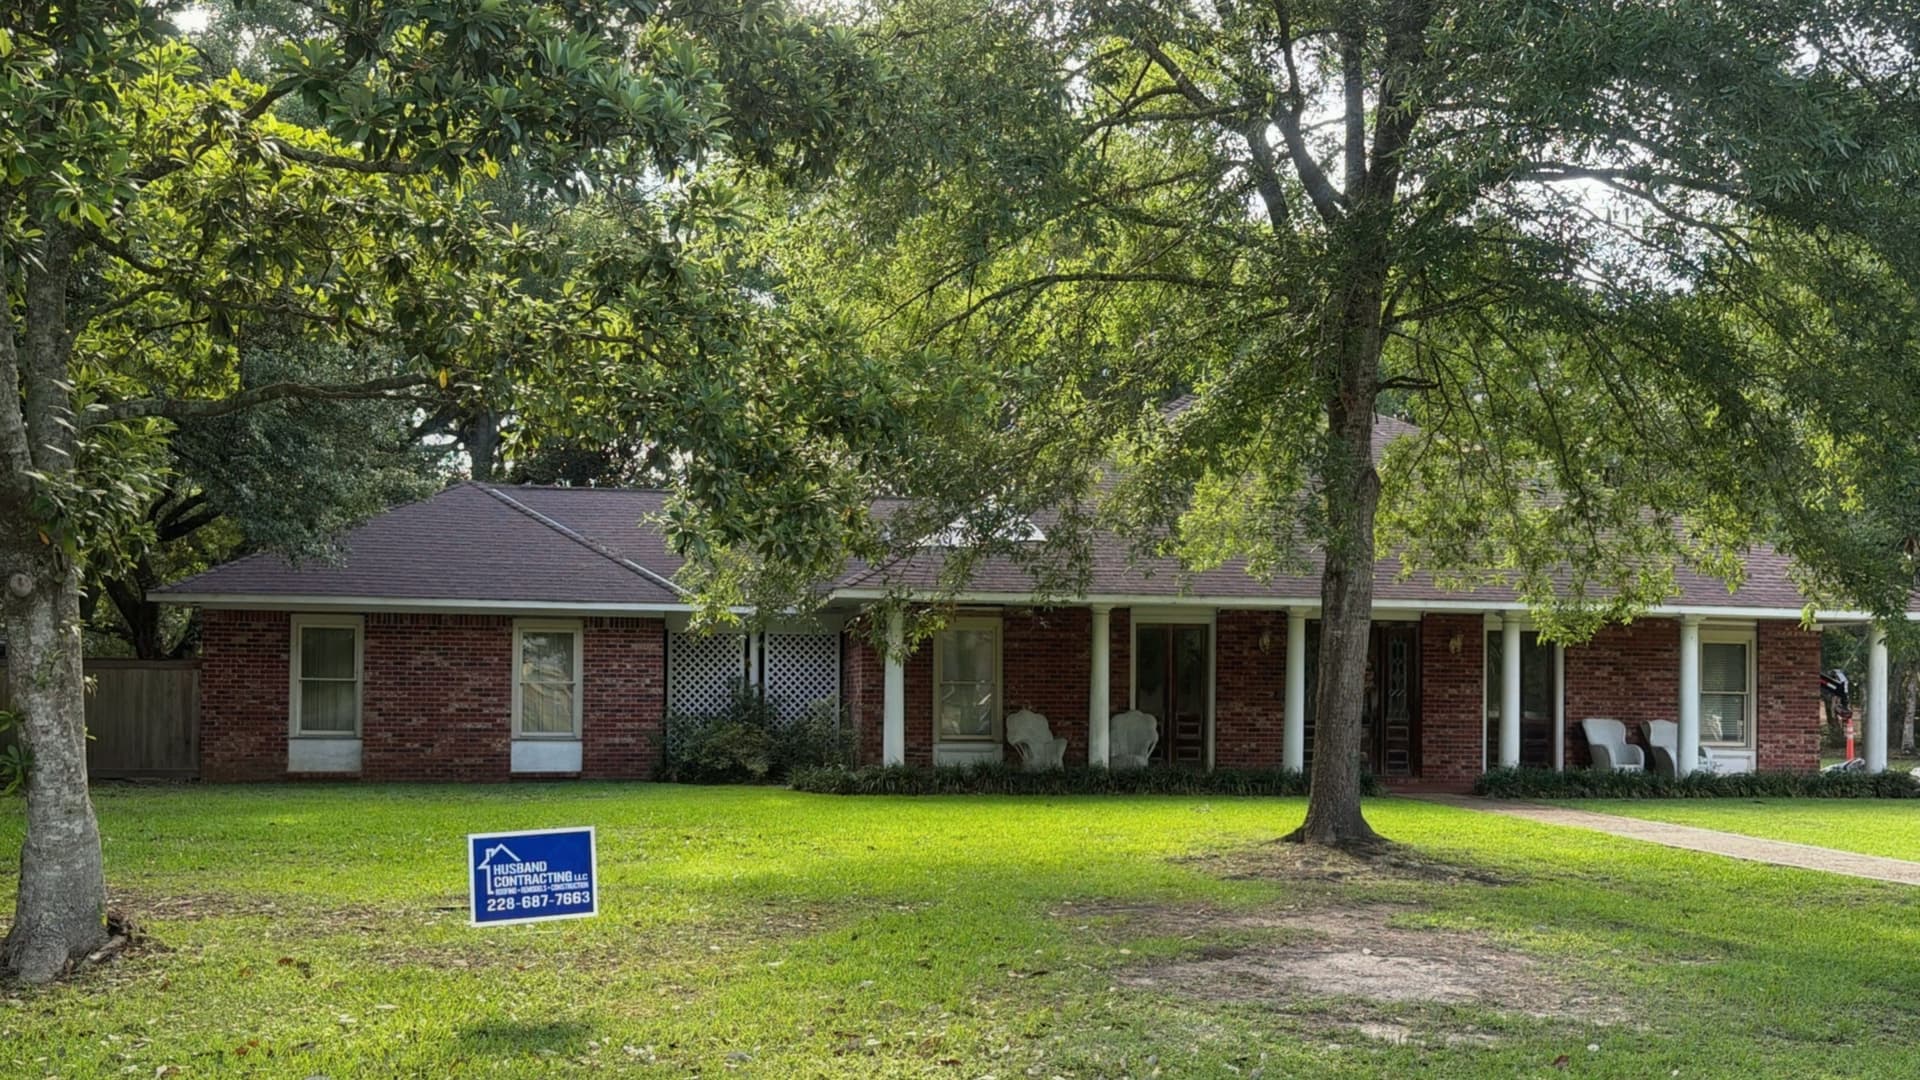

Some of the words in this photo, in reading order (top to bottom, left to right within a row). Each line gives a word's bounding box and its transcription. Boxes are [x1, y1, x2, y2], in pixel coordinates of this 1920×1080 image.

[493, 861, 547, 875] HUSBAND
[494, 871, 572, 887] CONTRACTING
[574, 873, 588, 881] LLC
[487, 891, 590, 911] 228-687-7663
